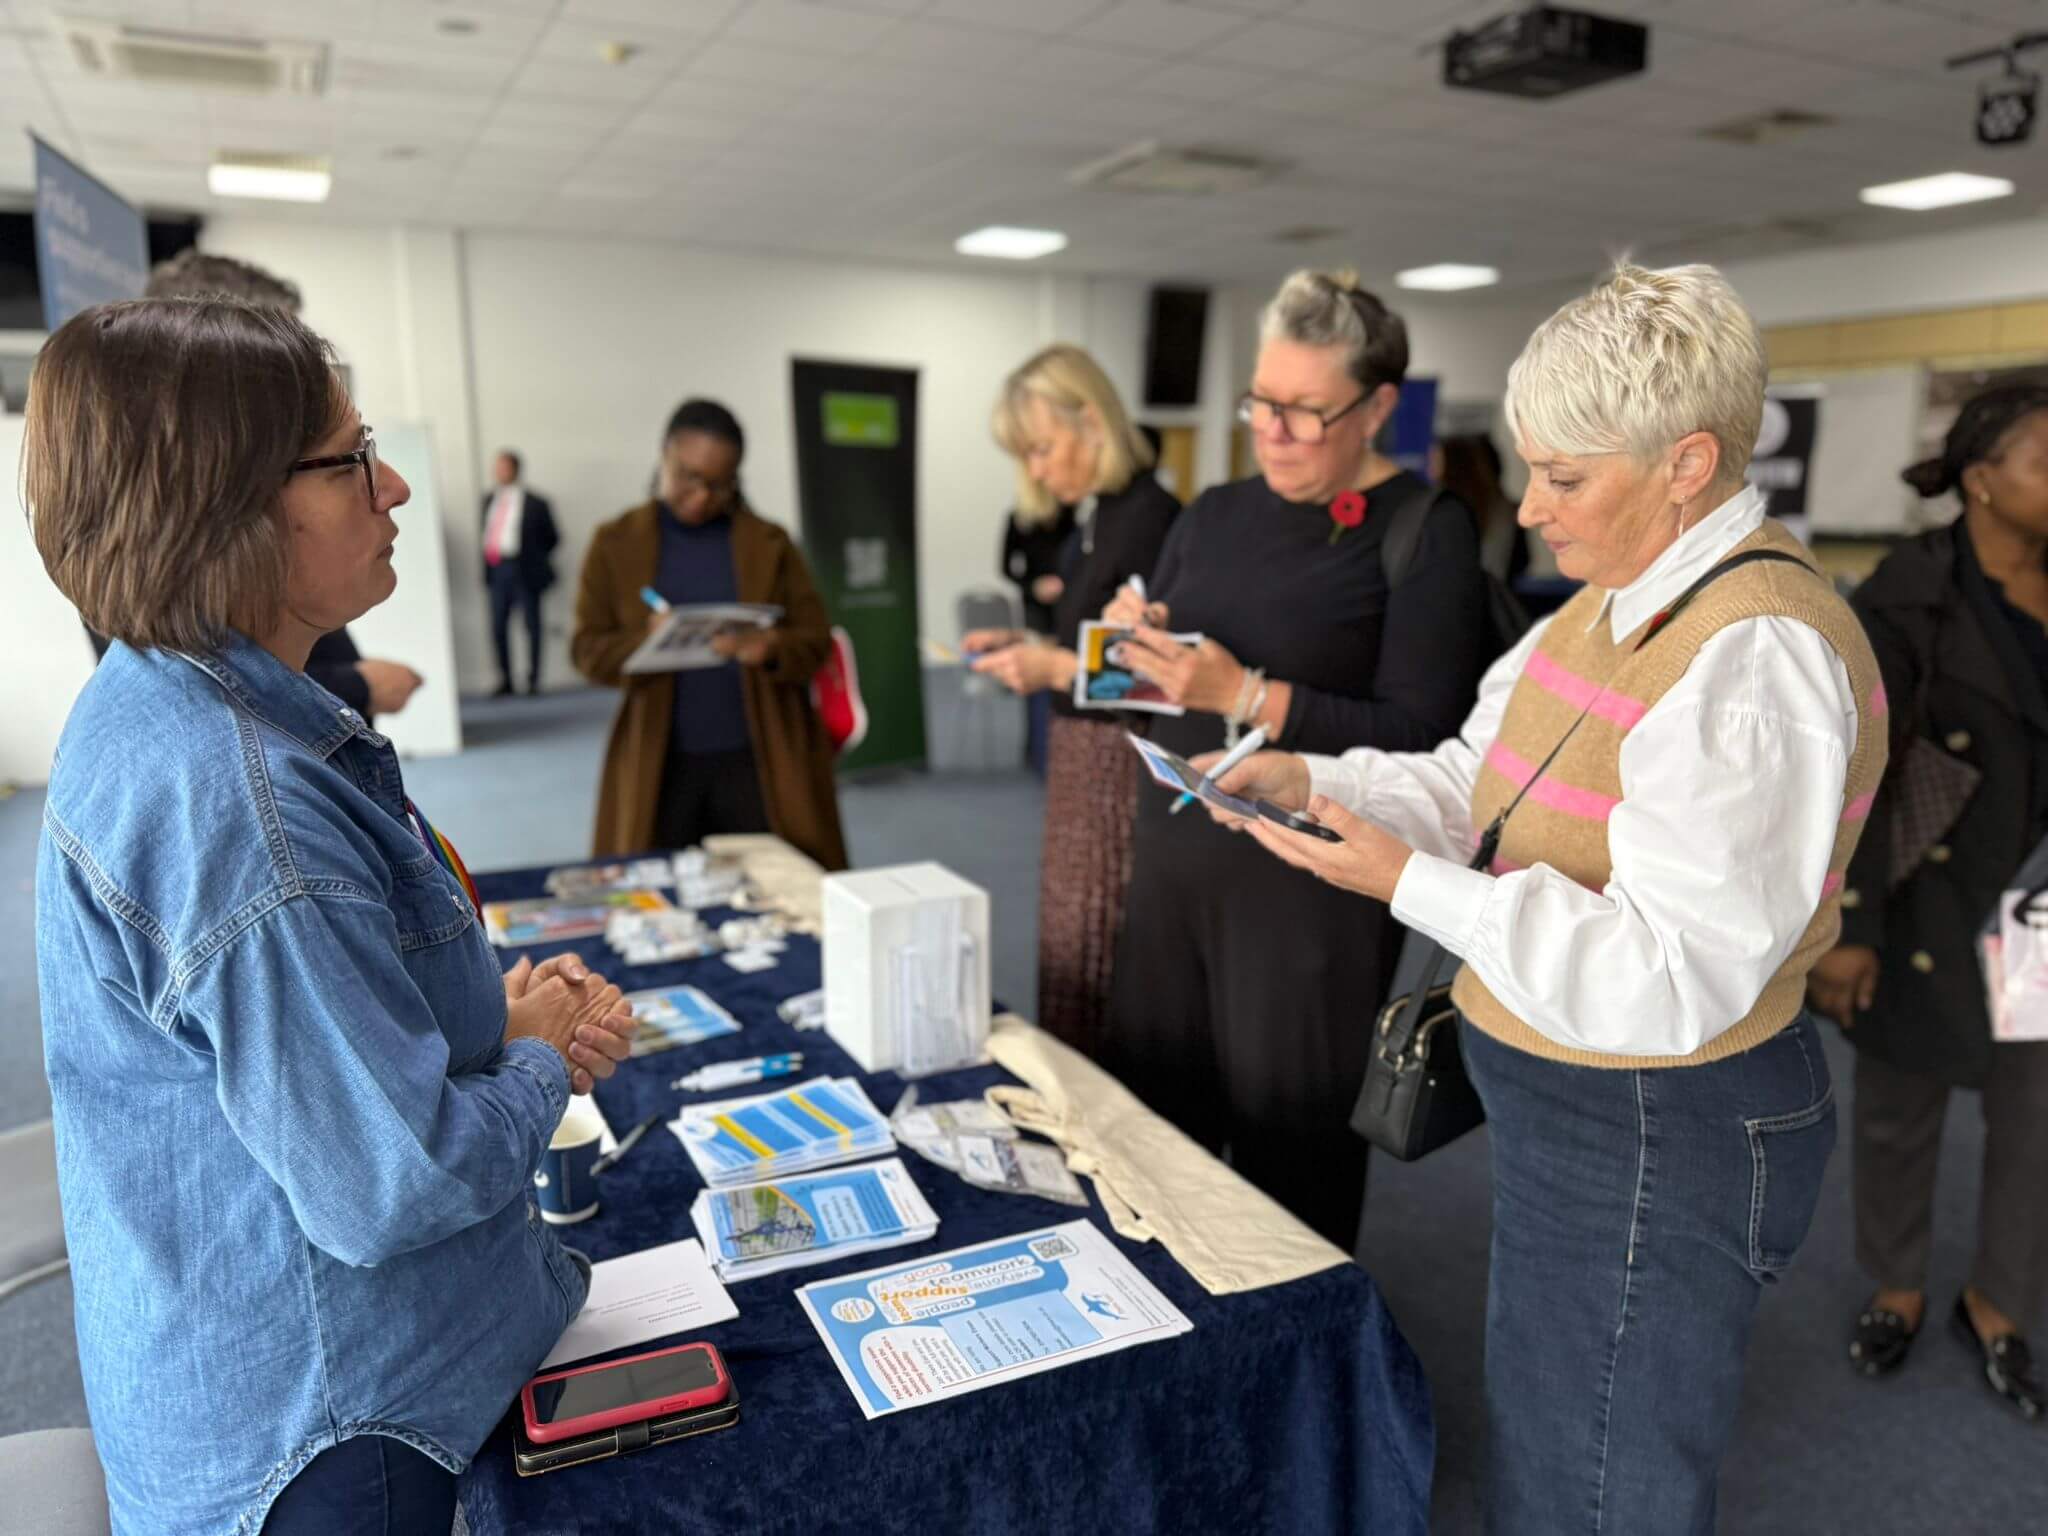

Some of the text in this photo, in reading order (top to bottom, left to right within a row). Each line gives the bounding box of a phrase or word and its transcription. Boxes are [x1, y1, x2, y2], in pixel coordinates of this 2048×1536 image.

[903, 1263, 948, 1282] good
[929, 1257, 1030, 1286] teamwork
[880, 1283, 969, 1302] support
[915, 1298, 971, 1318] people
